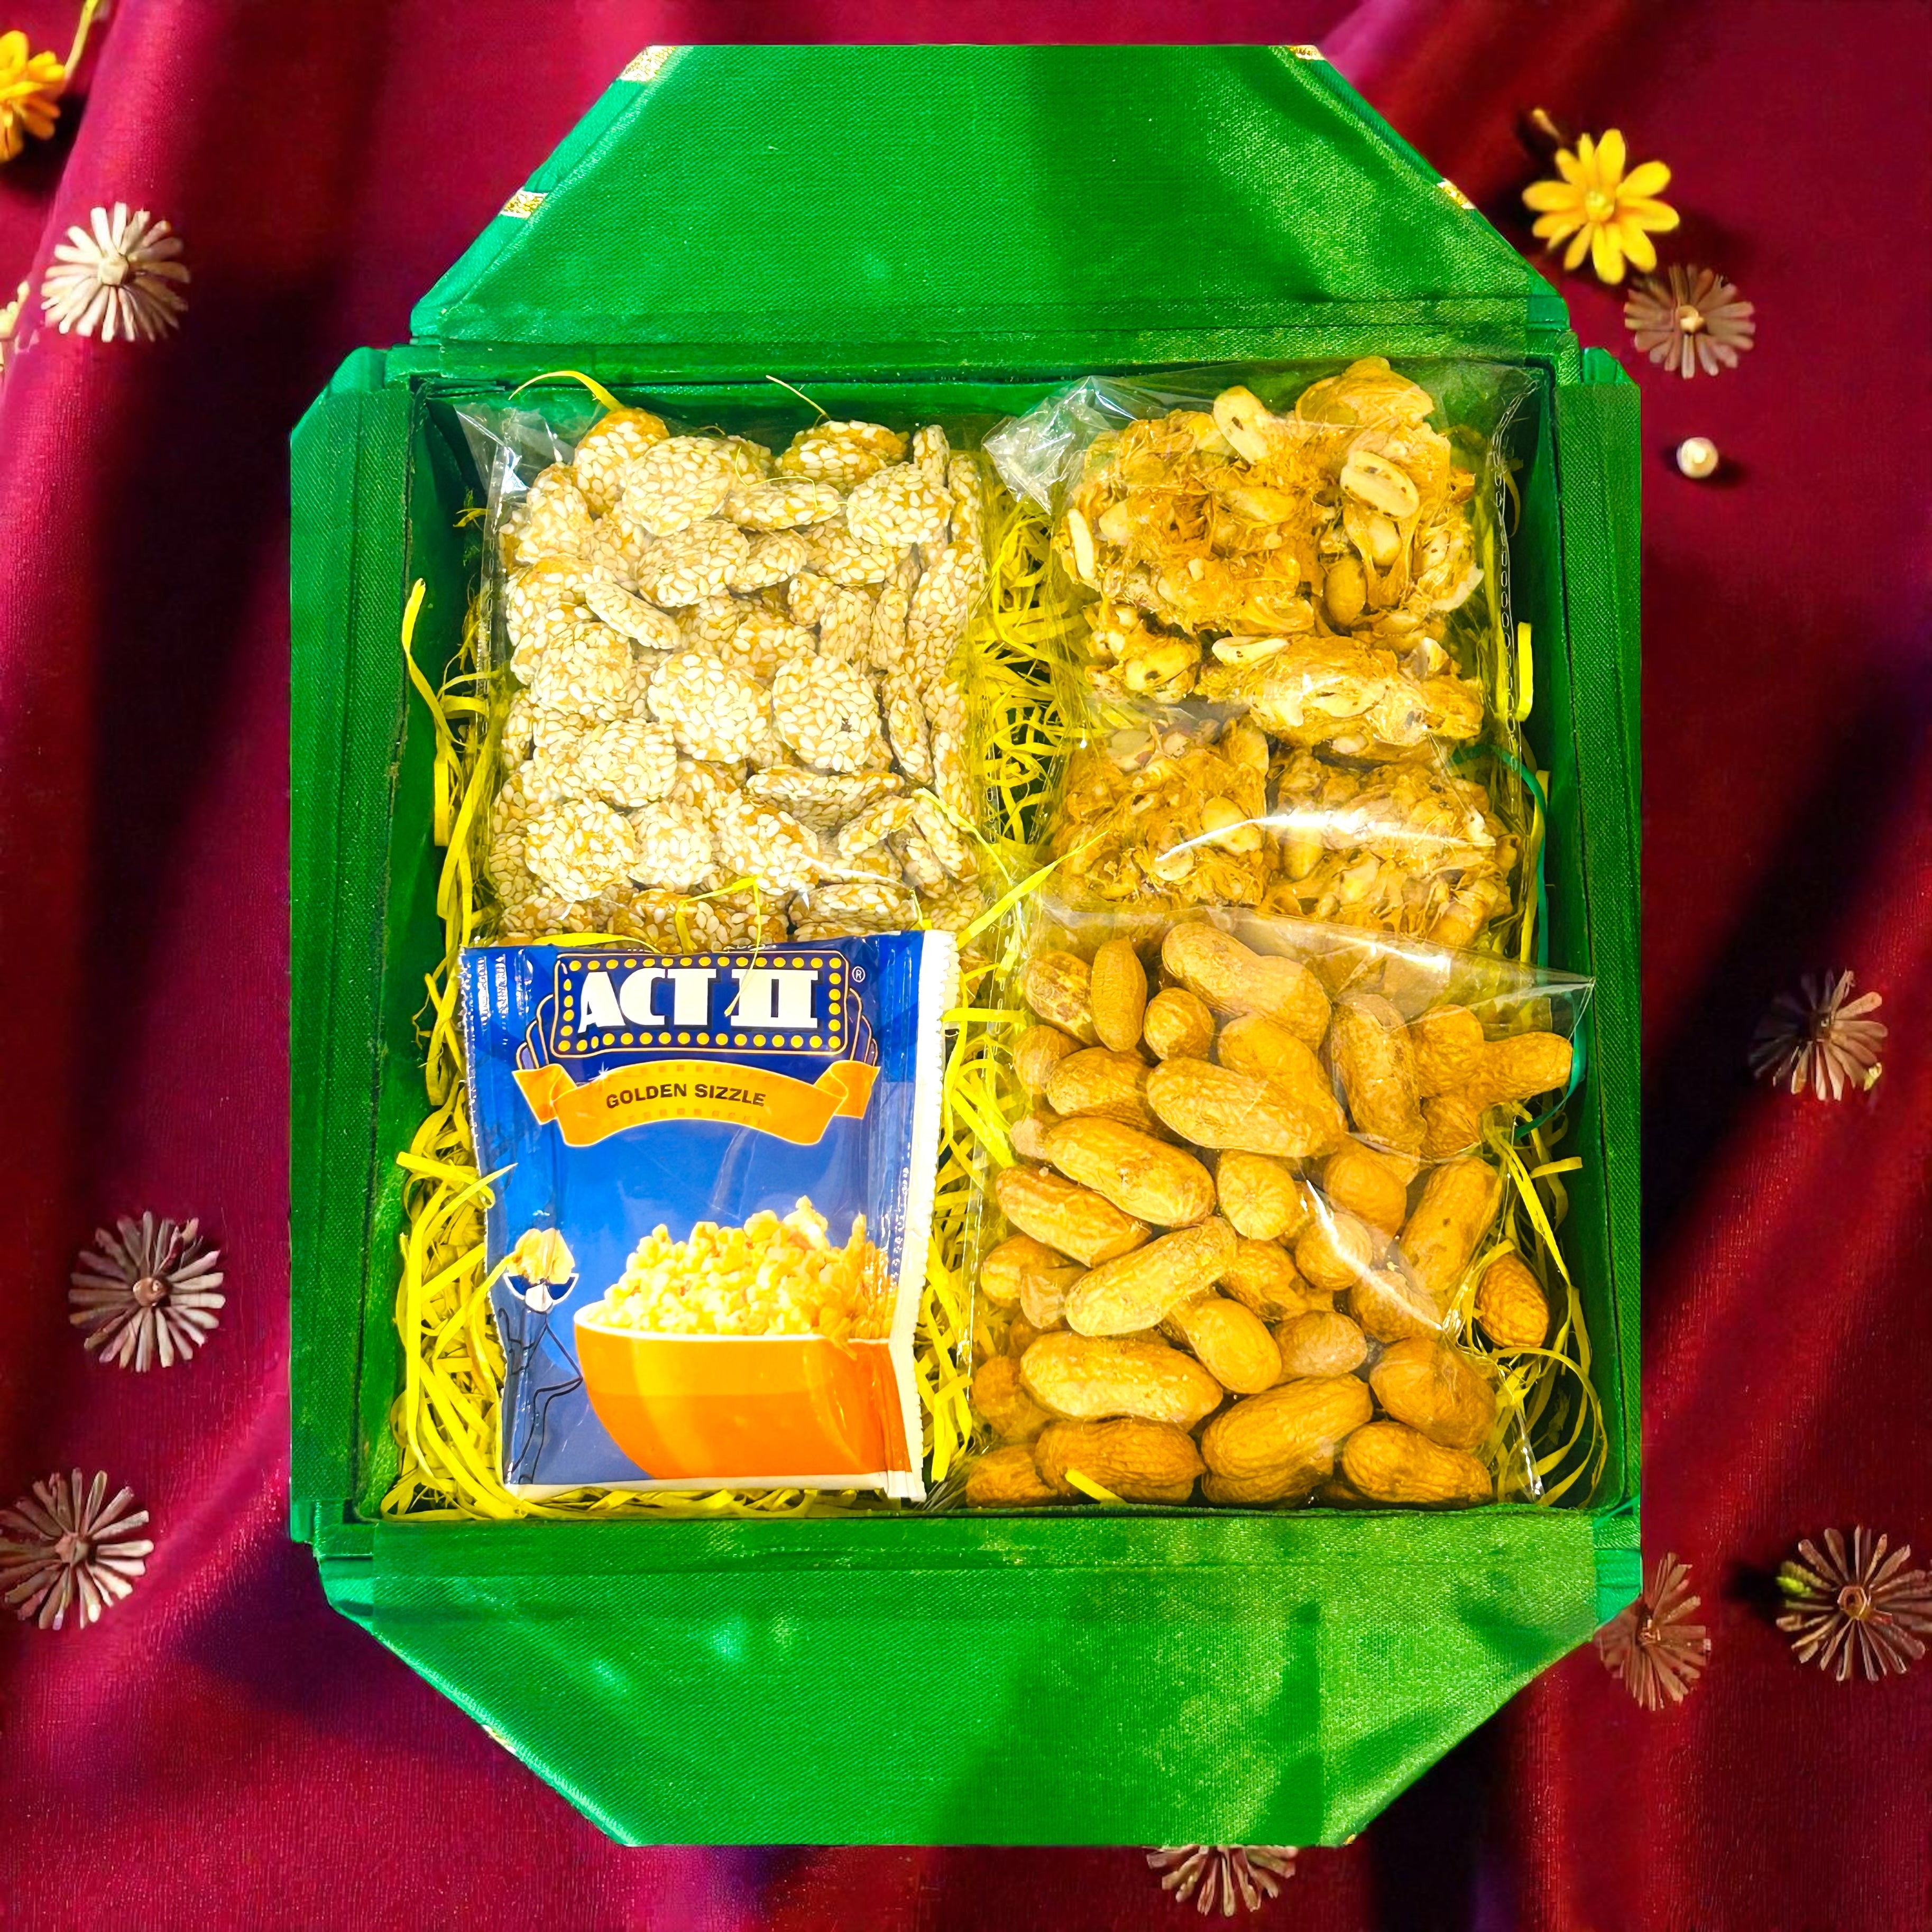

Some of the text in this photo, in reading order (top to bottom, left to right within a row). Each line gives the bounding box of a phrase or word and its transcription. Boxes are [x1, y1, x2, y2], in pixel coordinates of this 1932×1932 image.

[578, 967, 717, 1034] ACT
[731, 968, 818, 1028] II
[606, 1083, 767, 1109] GOLDEN SIZZLE
